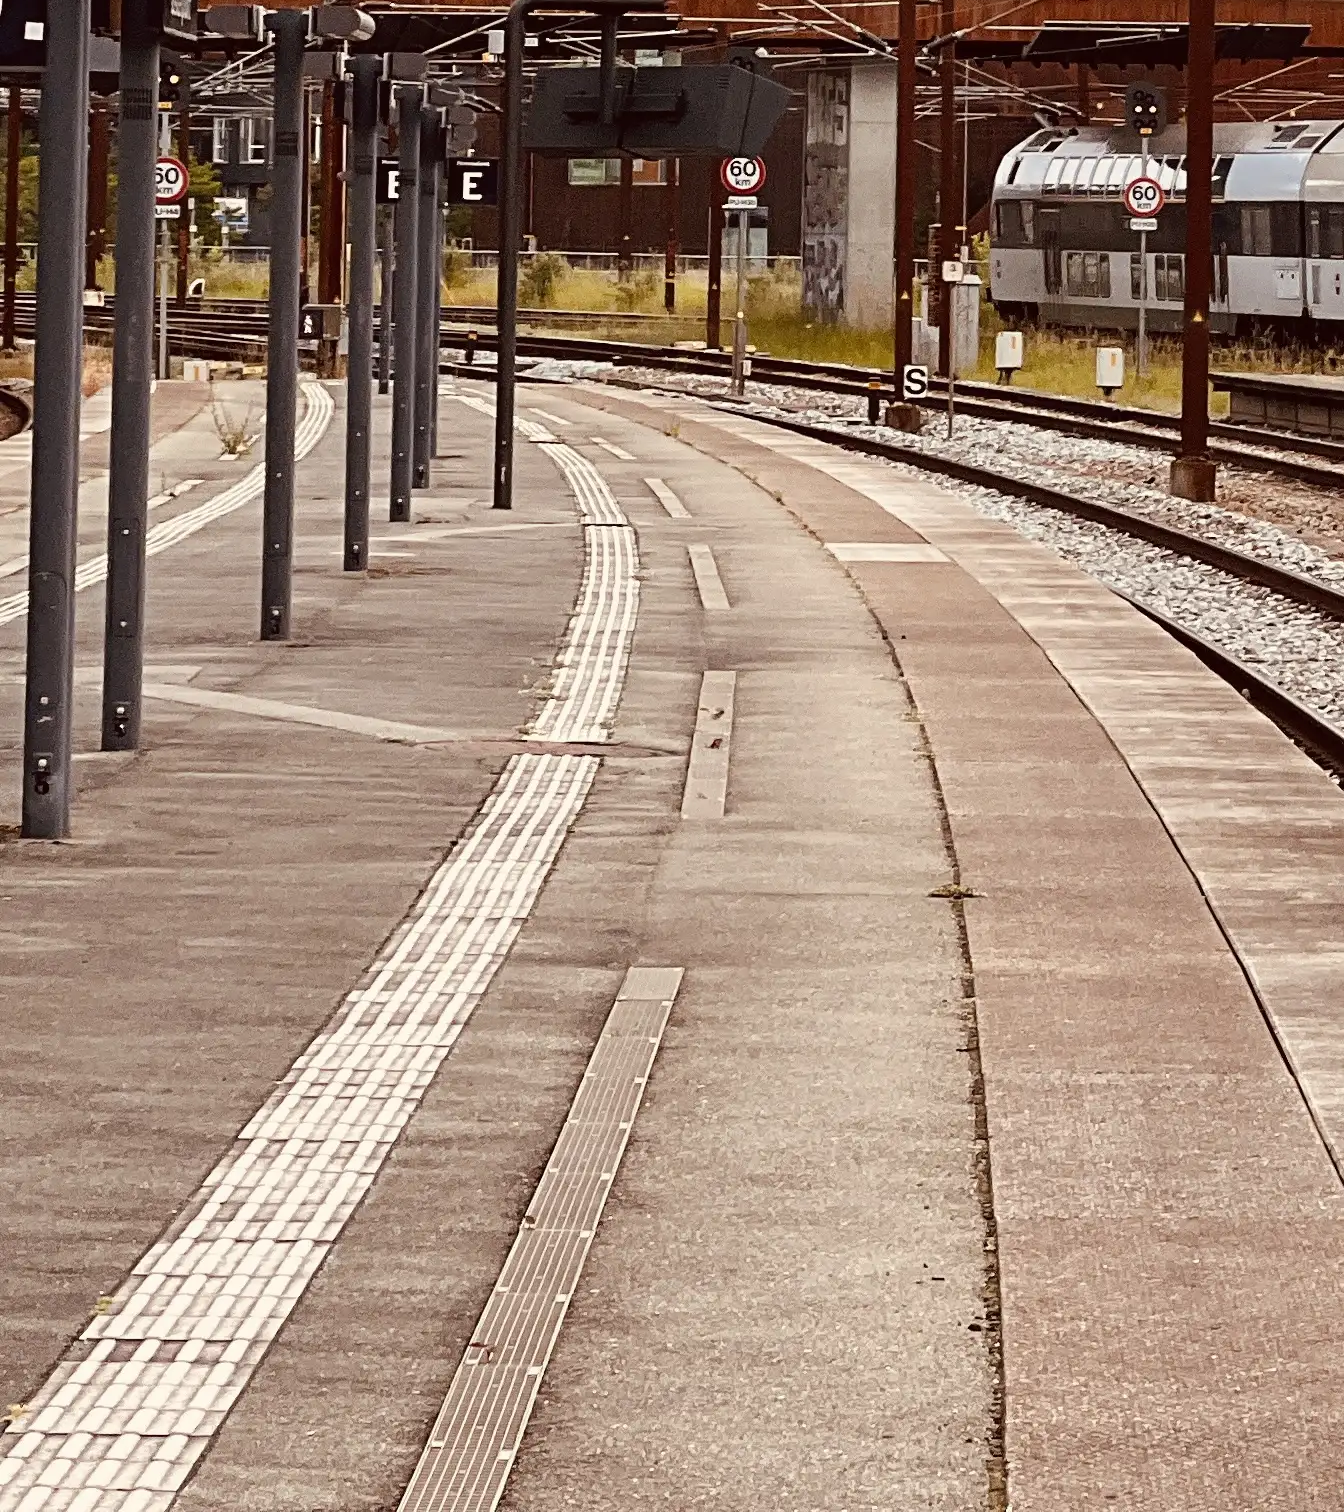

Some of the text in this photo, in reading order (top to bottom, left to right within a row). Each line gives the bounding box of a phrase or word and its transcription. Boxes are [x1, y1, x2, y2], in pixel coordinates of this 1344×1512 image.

[730, 160, 756, 177] 60
[387, 170, 400, 199] E
[462, 171, 483, 201] E
[735, 178, 751, 186] km
[1132, 185, 1157, 201] 60
[1136, 201, 1152, 210] km
[904, 368, 927, 395] S
